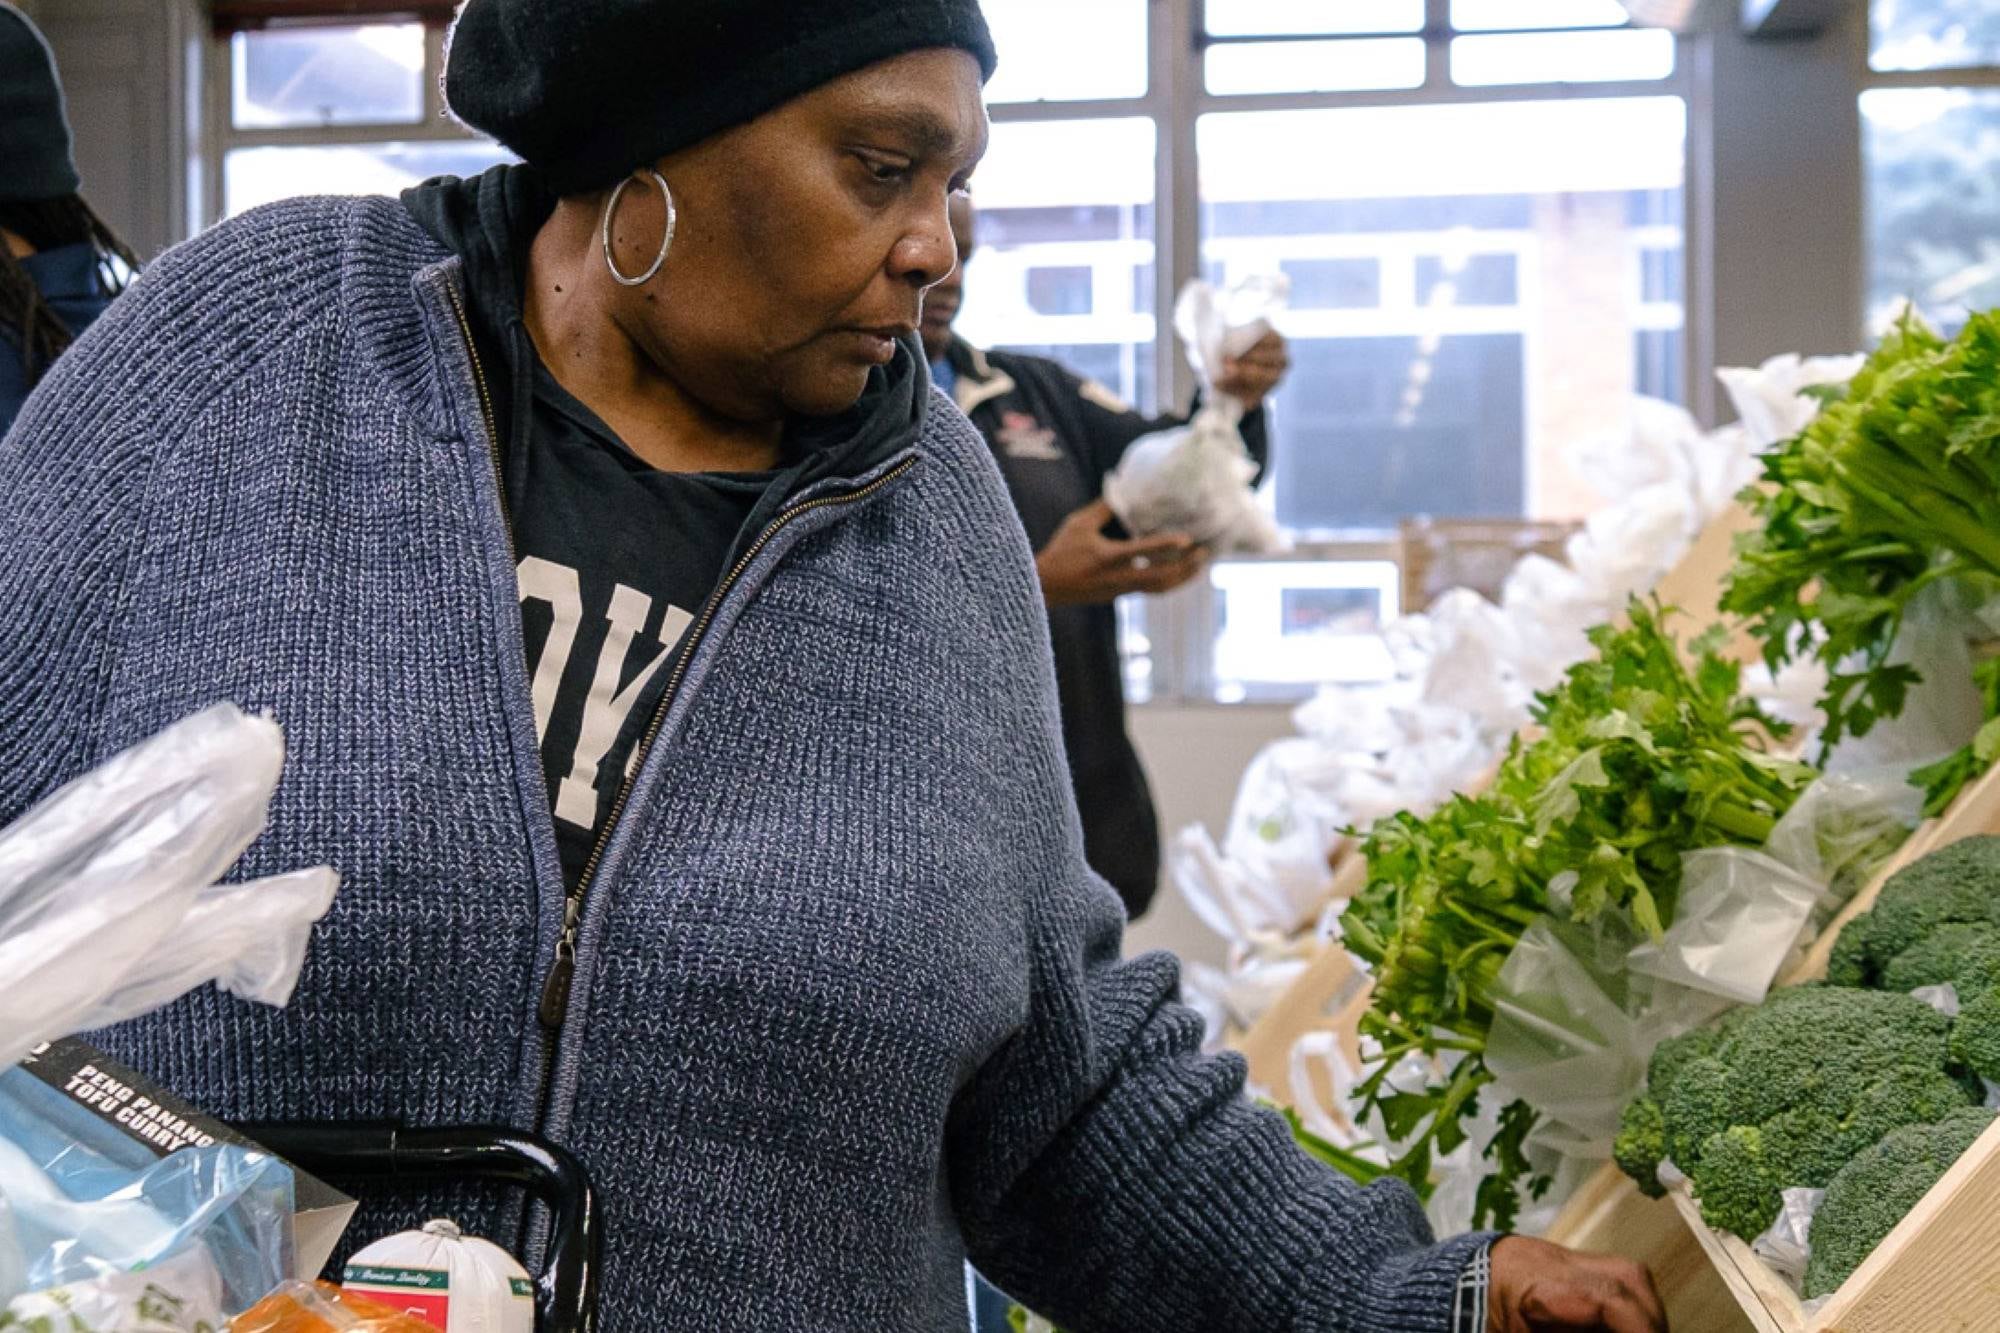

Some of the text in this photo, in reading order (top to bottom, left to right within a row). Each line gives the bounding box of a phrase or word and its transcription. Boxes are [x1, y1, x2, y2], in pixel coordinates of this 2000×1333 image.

[63, 1075, 187, 1152] TOFU CURRY
[76, 1064, 216, 1148] PENG PANANG
[362, 1269, 394, 1281] Premium
[396, 1271, 431, 1286] Quality
